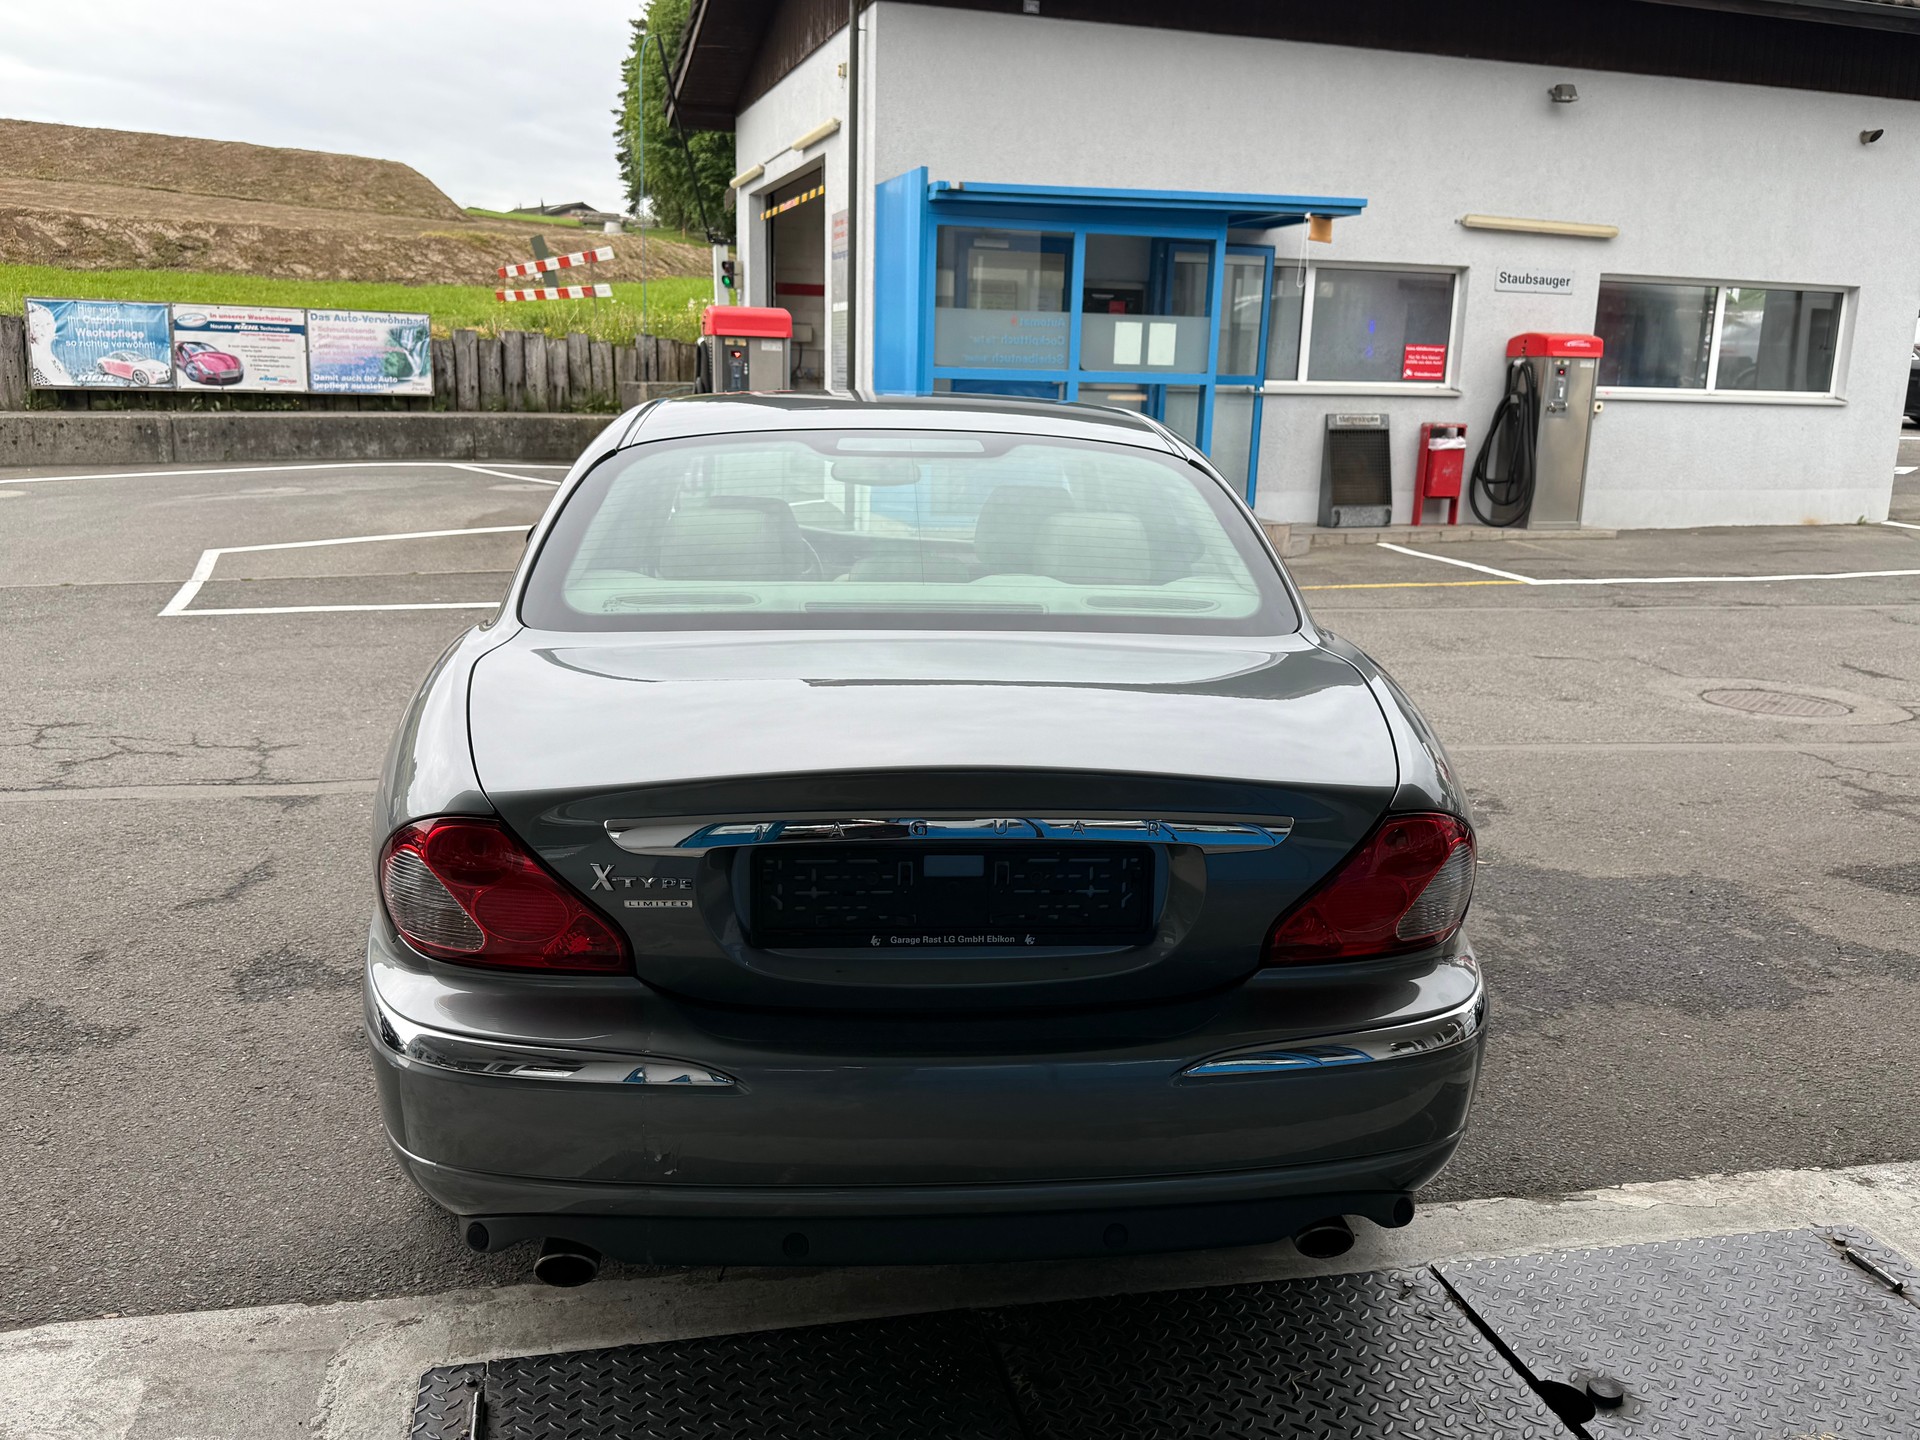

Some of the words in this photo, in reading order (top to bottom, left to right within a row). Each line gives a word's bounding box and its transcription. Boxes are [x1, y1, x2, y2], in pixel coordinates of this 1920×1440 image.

[1499, 271, 1571, 288] Staubsauger
[77, 304, 97, 313] Hier
[99, 304, 118, 313] wird
[67, 315, 80, 324] Ihr
[247, 314, 293, 322] Waschanlage
[310, 312, 331, 322] Das
[334, 313, 430, 326] Auto-Verwöhnbad!
[210, 323, 233, 331] Neueste
[233, 322, 259, 331] KIEHL
[75, 328, 145, 340] Wachspflege
[65, 340, 77, 348] so
[79, 339, 109, 349] richtig
[111, 340, 156, 350] verwöhnt!
[313, 373, 339, 382] Damit
[341, 375, 362, 383] auch
[363, 375, 377, 383] Ihr
[378, 375, 398, 384] Auto
[313, 382, 349, 391] gepflegt
[752, 819, 1162, 842] JAGUAR
[590, 863, 693, 891] X-TYPE
[628, 900, 689, 908] LIMITED
[890, 935, 921, 945] Garage
[922, 935, 942, 944] Rast
[943, 935, 956, 944] LG
[957, 935, 985, 944] GmbH
[986, 935, 1016, 944] Ebikon
